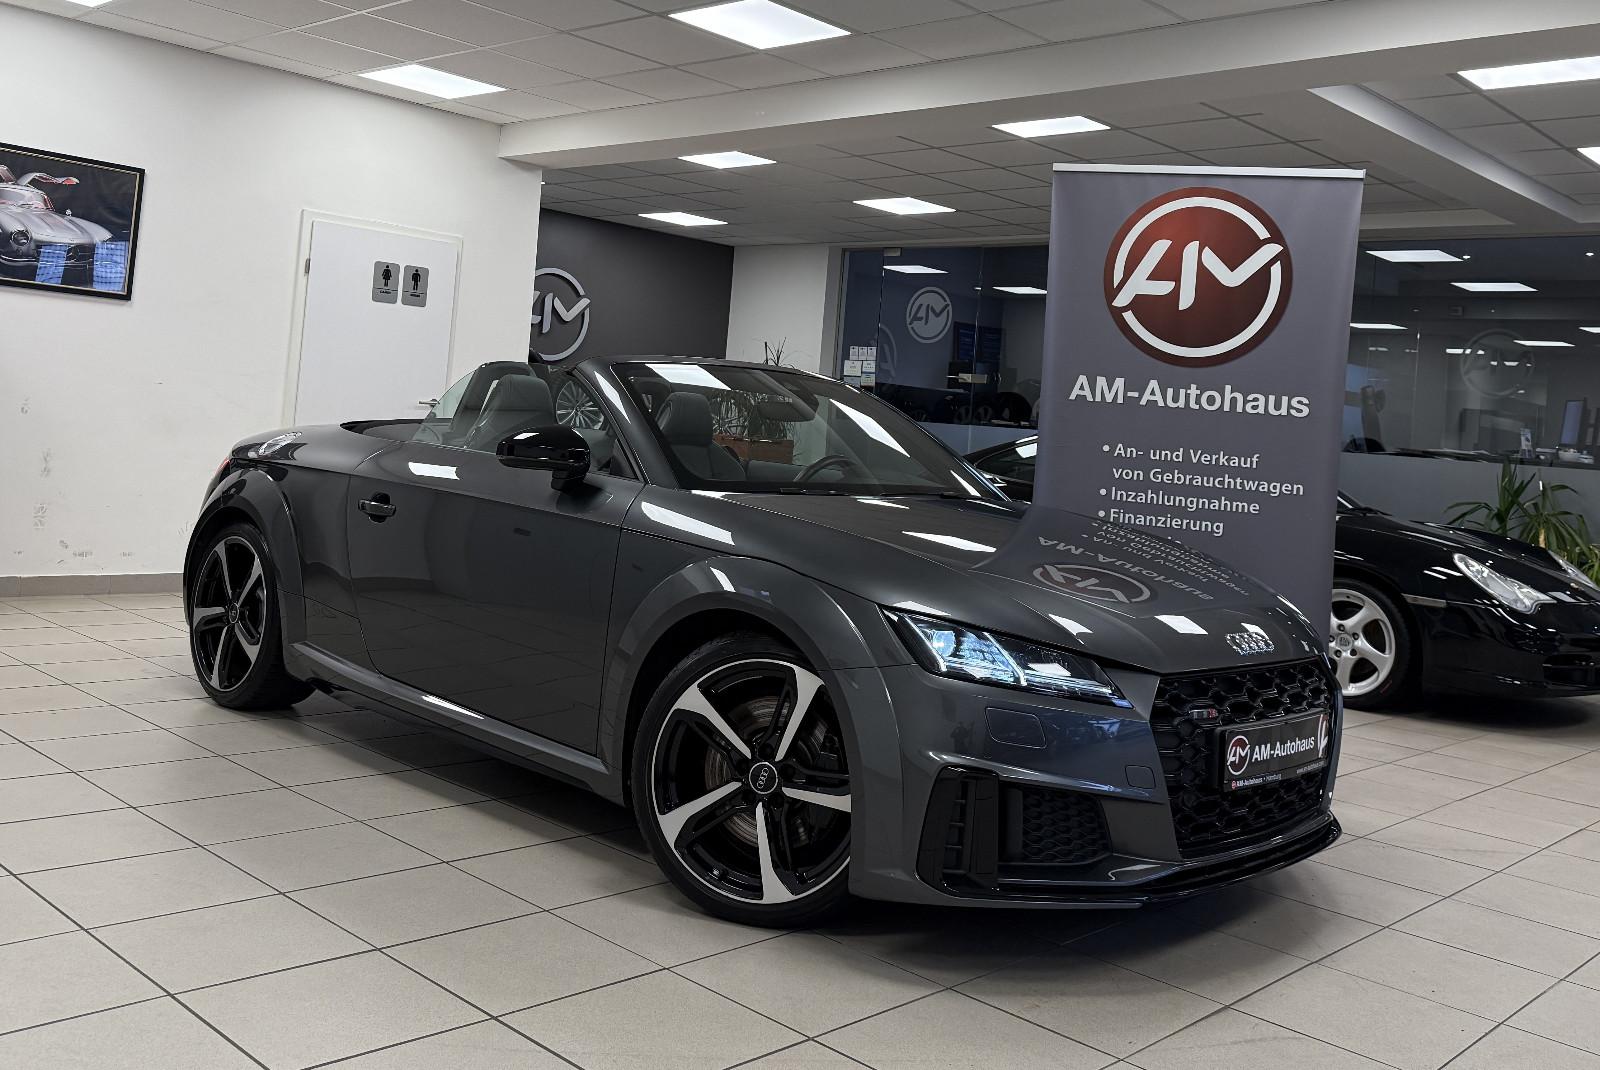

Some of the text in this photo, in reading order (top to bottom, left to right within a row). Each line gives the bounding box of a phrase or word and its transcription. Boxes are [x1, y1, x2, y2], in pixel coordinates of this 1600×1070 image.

[1068, 374, 1311, 419] AM-Autohaus
[1114, 443, 1260, 469] An- und Verkauf
[1112, 467, 1305, 497] von Gebrauchtwagen
[1110, 486, 1261, 515] Inzahlungnahme
[1109, 508, 1225, 537] Finanzierung
[1252, 736, 1315, 763] AM-Autohaus
